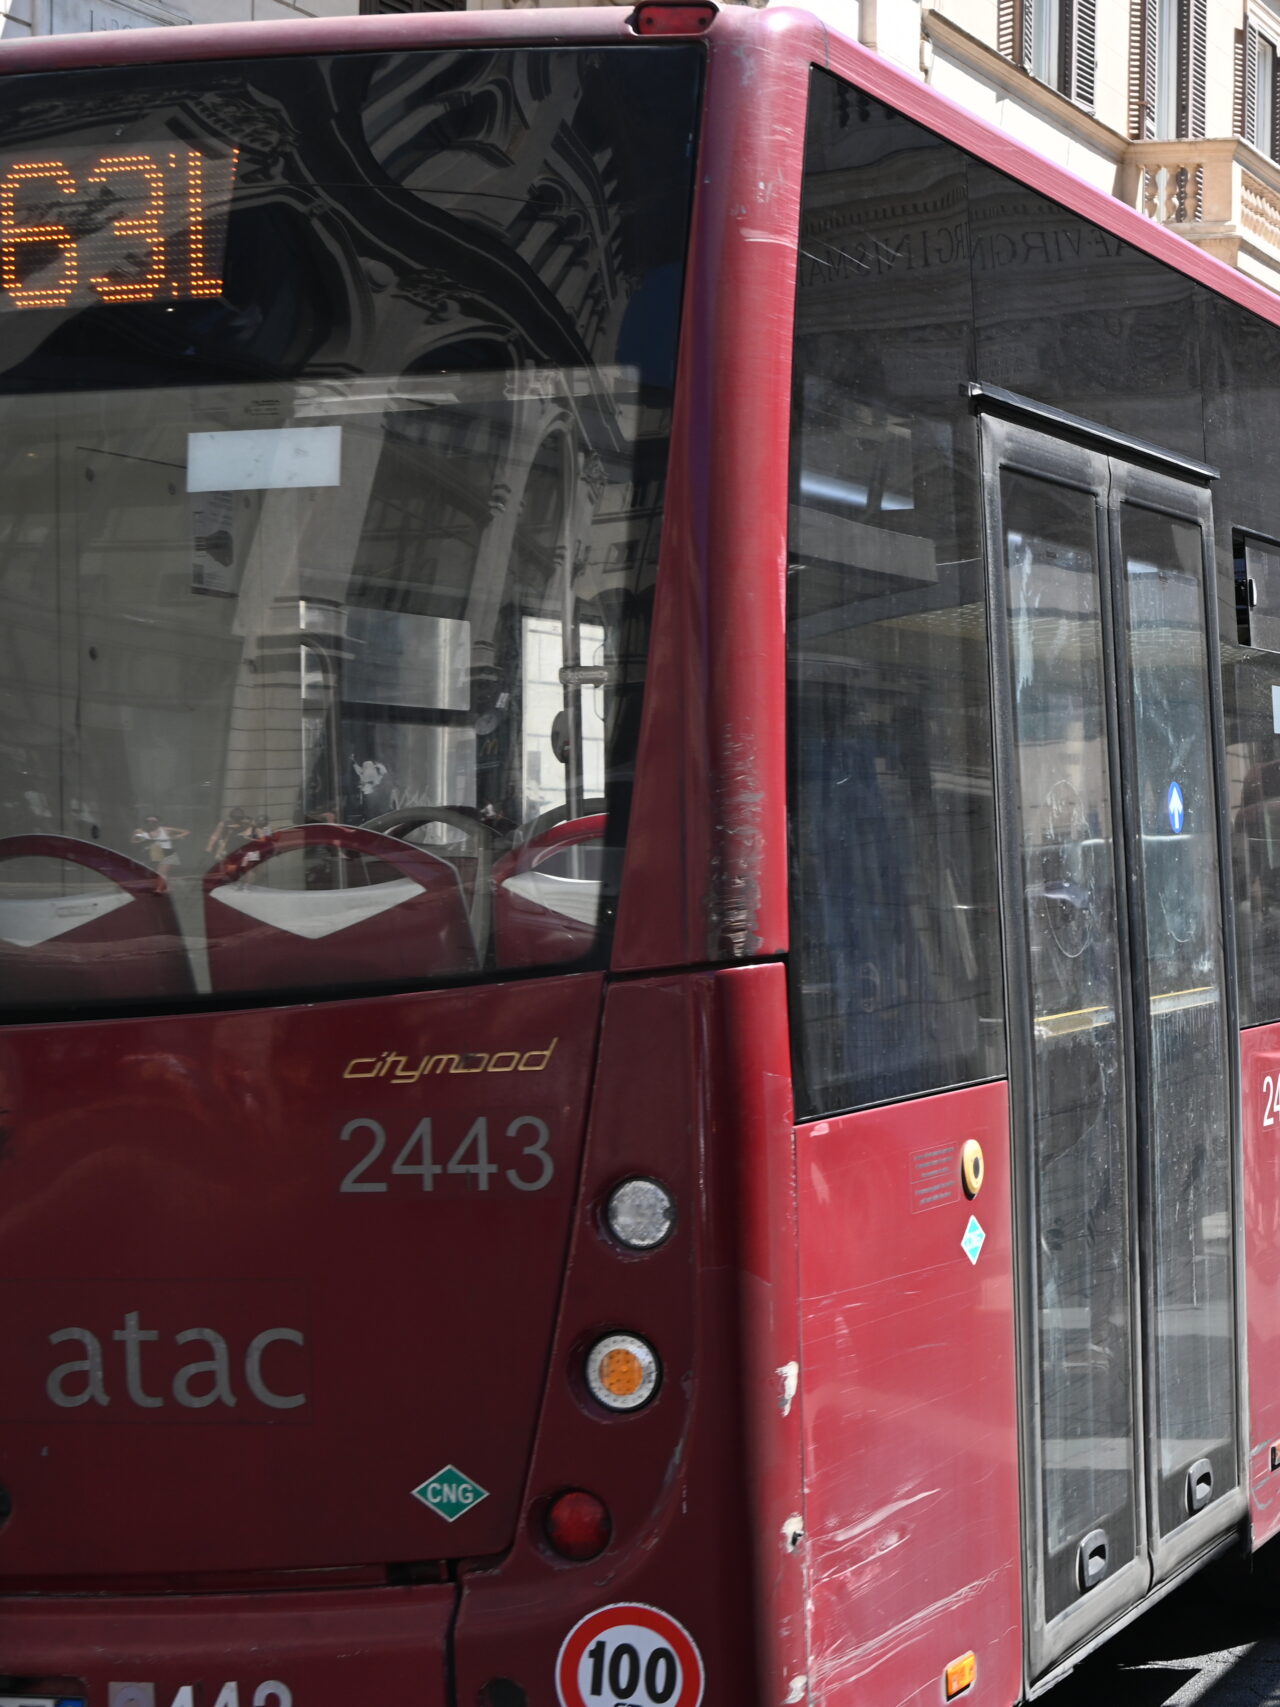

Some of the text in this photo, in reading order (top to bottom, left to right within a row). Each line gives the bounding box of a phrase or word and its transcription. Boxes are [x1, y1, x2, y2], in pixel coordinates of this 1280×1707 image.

[343, 1037, 559, 1083] citymood
[339, 1115, 555, 1192] 2443
[45, 1310, 307, 1409] atac
[426, 1482, 475, 1504] CNG
[587, 1640, 678, 1704] 100
